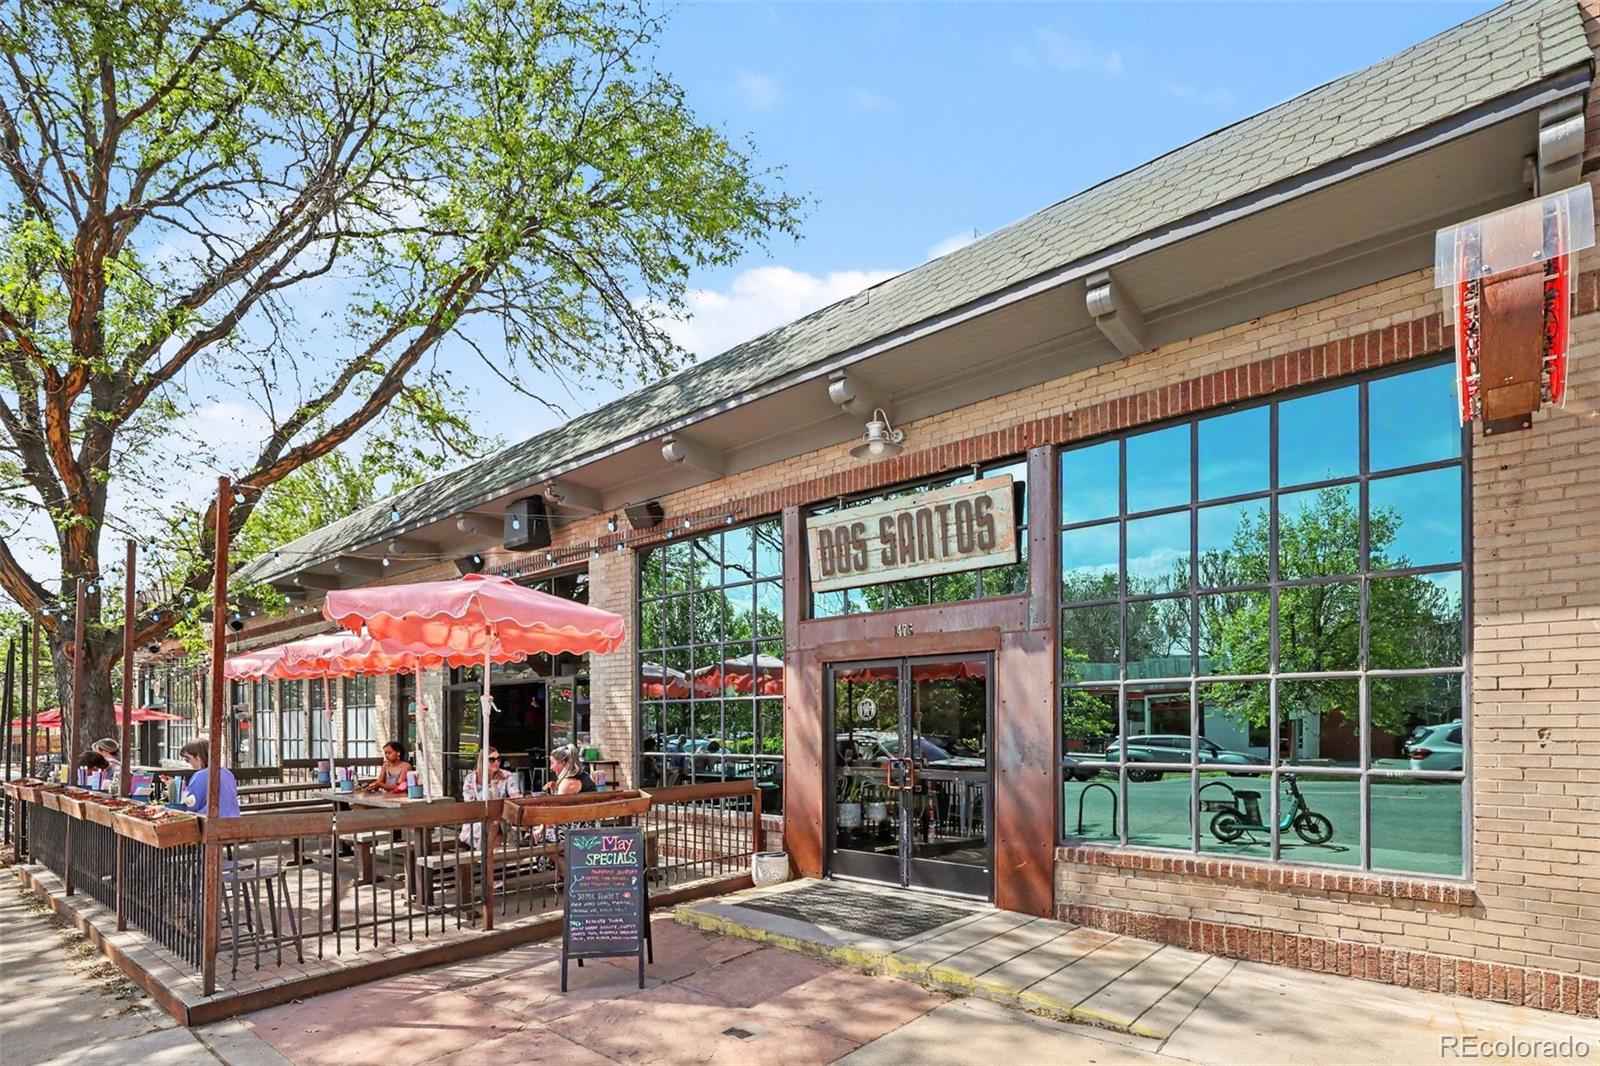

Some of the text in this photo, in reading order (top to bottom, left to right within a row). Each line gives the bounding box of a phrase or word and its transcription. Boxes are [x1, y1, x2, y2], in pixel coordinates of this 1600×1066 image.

[818, 495, 996, 577] DOS SANTOS
[601, 835, 634, 854] May
[585, 851, 637, 866] SPECIALS
